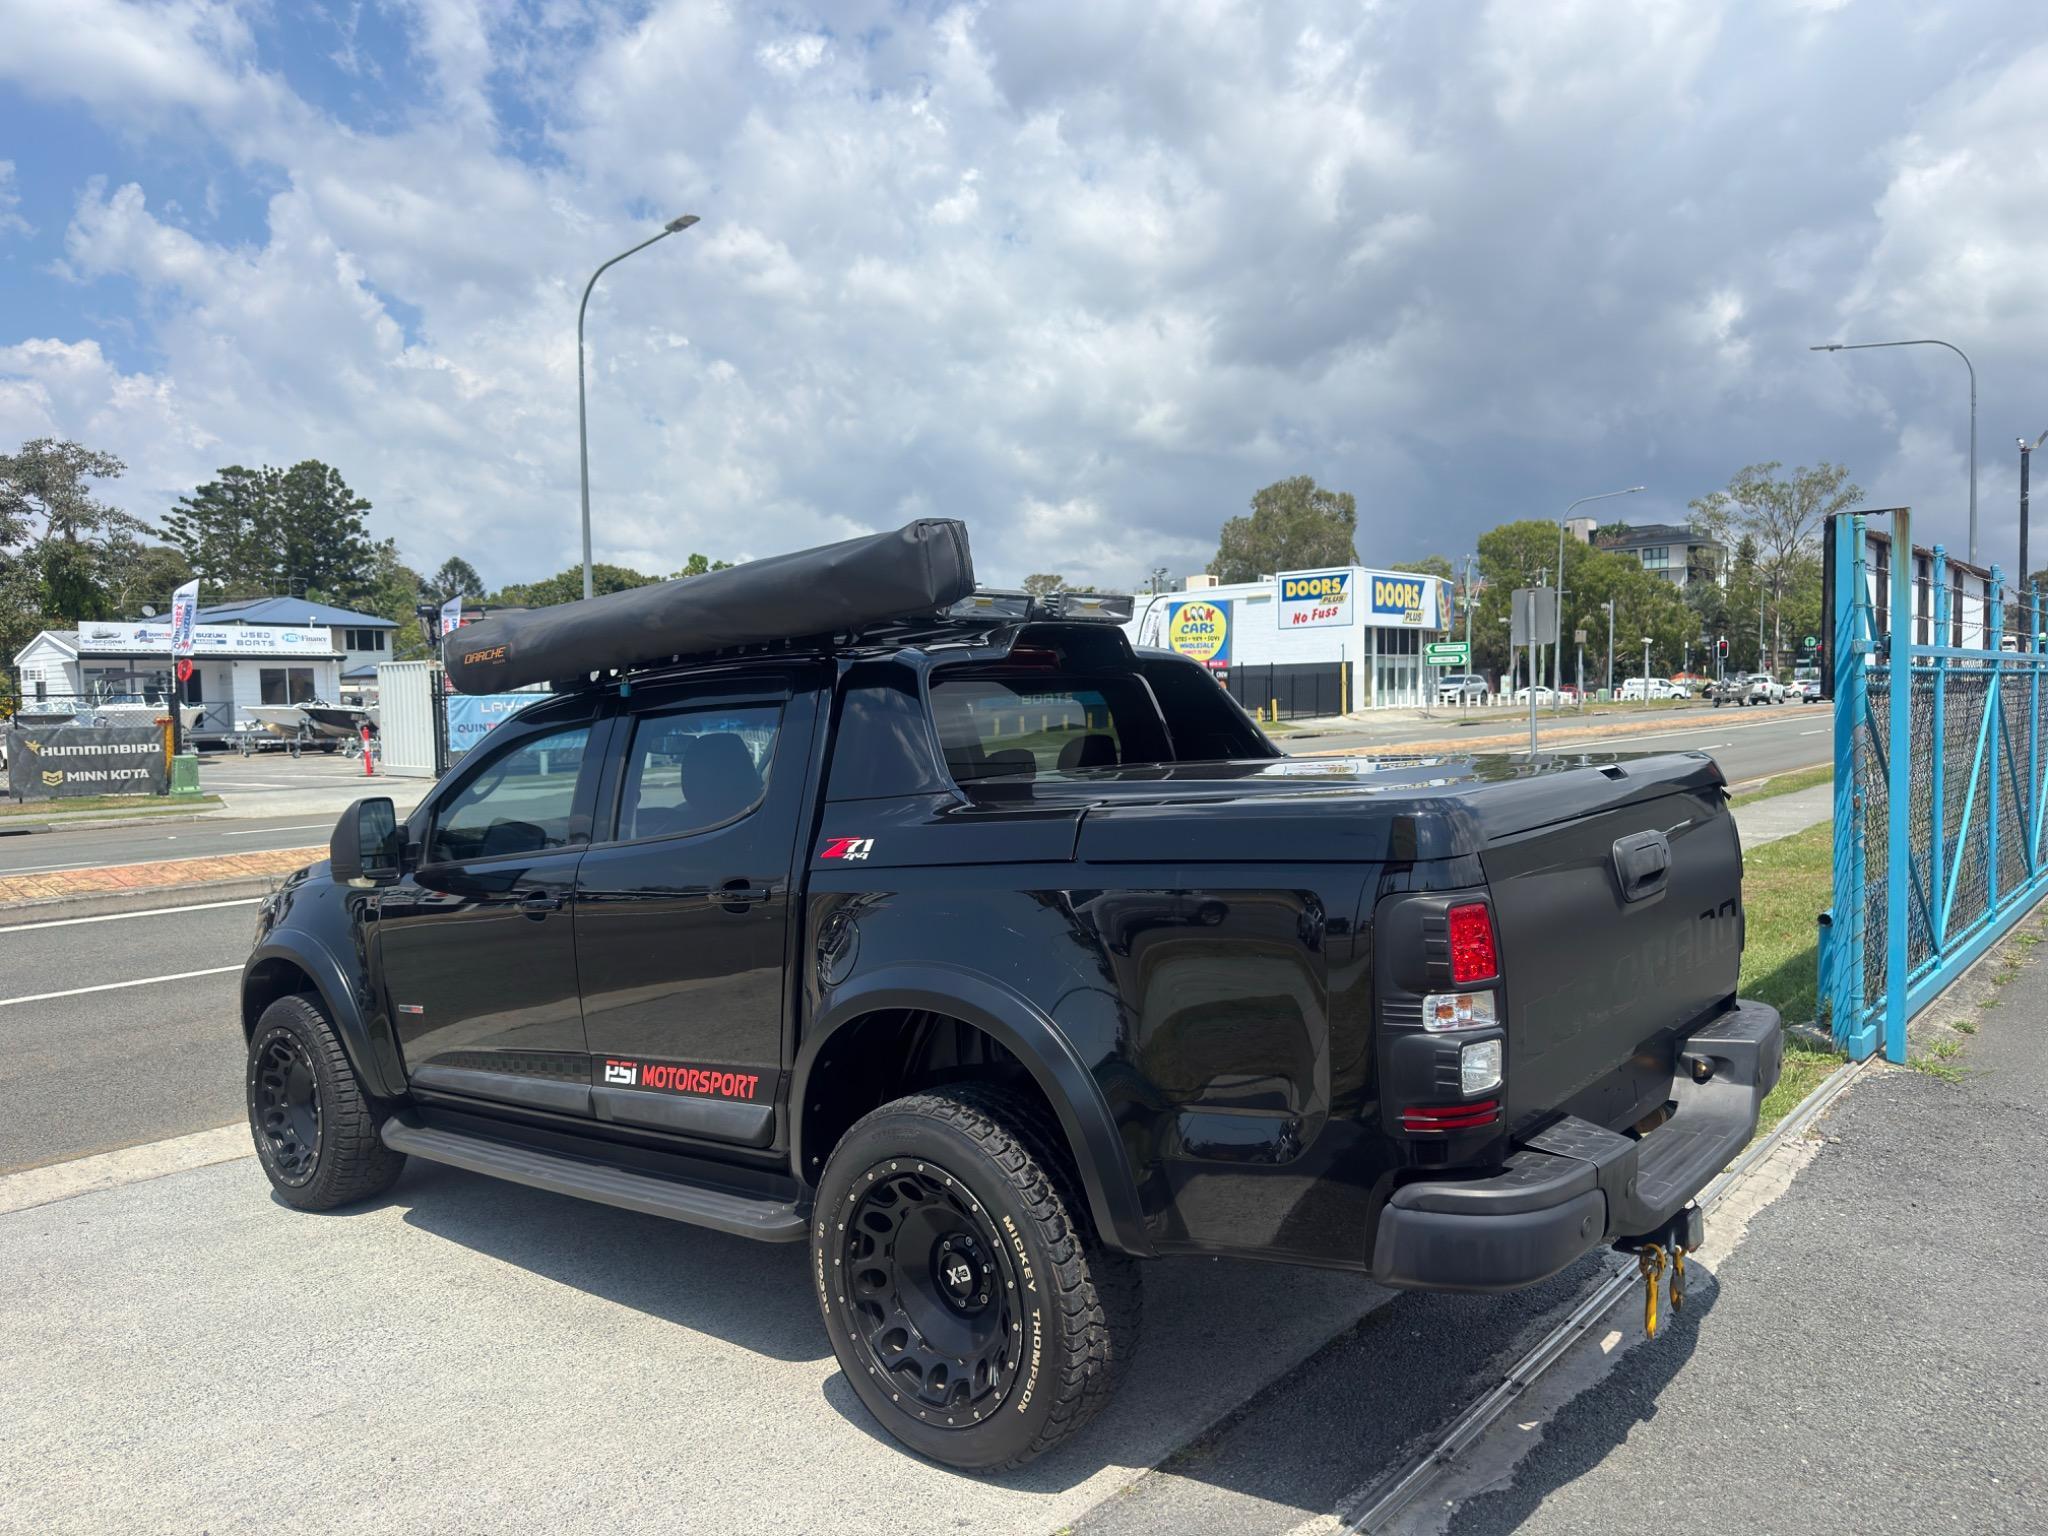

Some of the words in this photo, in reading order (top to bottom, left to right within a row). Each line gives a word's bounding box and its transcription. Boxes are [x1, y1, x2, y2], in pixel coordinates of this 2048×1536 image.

[1286, 578, 1341, 598] DOORS
[1375, 581, 1420, 609] DOORS
[1322, 594, 1345, 603] PLUS
[183, 604, 193, 639] SUZUKI
[1183, 605, 1215, 622] LOOK
[1292, 612, 1308, 624] No
[1311, 606, 1339, 620] Fuss
[1405, 611, 1422, 622] PLUS
[240, 631, 271, 639] USED
[1181, 623, 1215, 634] CARS
[236, 639, 276, 647] BOATS
[301, 634, 327, 642] Finance
[464, 646, 507, 665] DARCHE
[40, 743, 161, 757] HUMMINBIRD
[67, 770, 108, 782] MINN
[110, 768, 150, 780] KOTA
[641, 1064, 759, 1099] MOTORSPORT
[1002, 1215, 1037, 1292] MICKEY
[1017, 1308, 1042, 1414] THOMPSON
